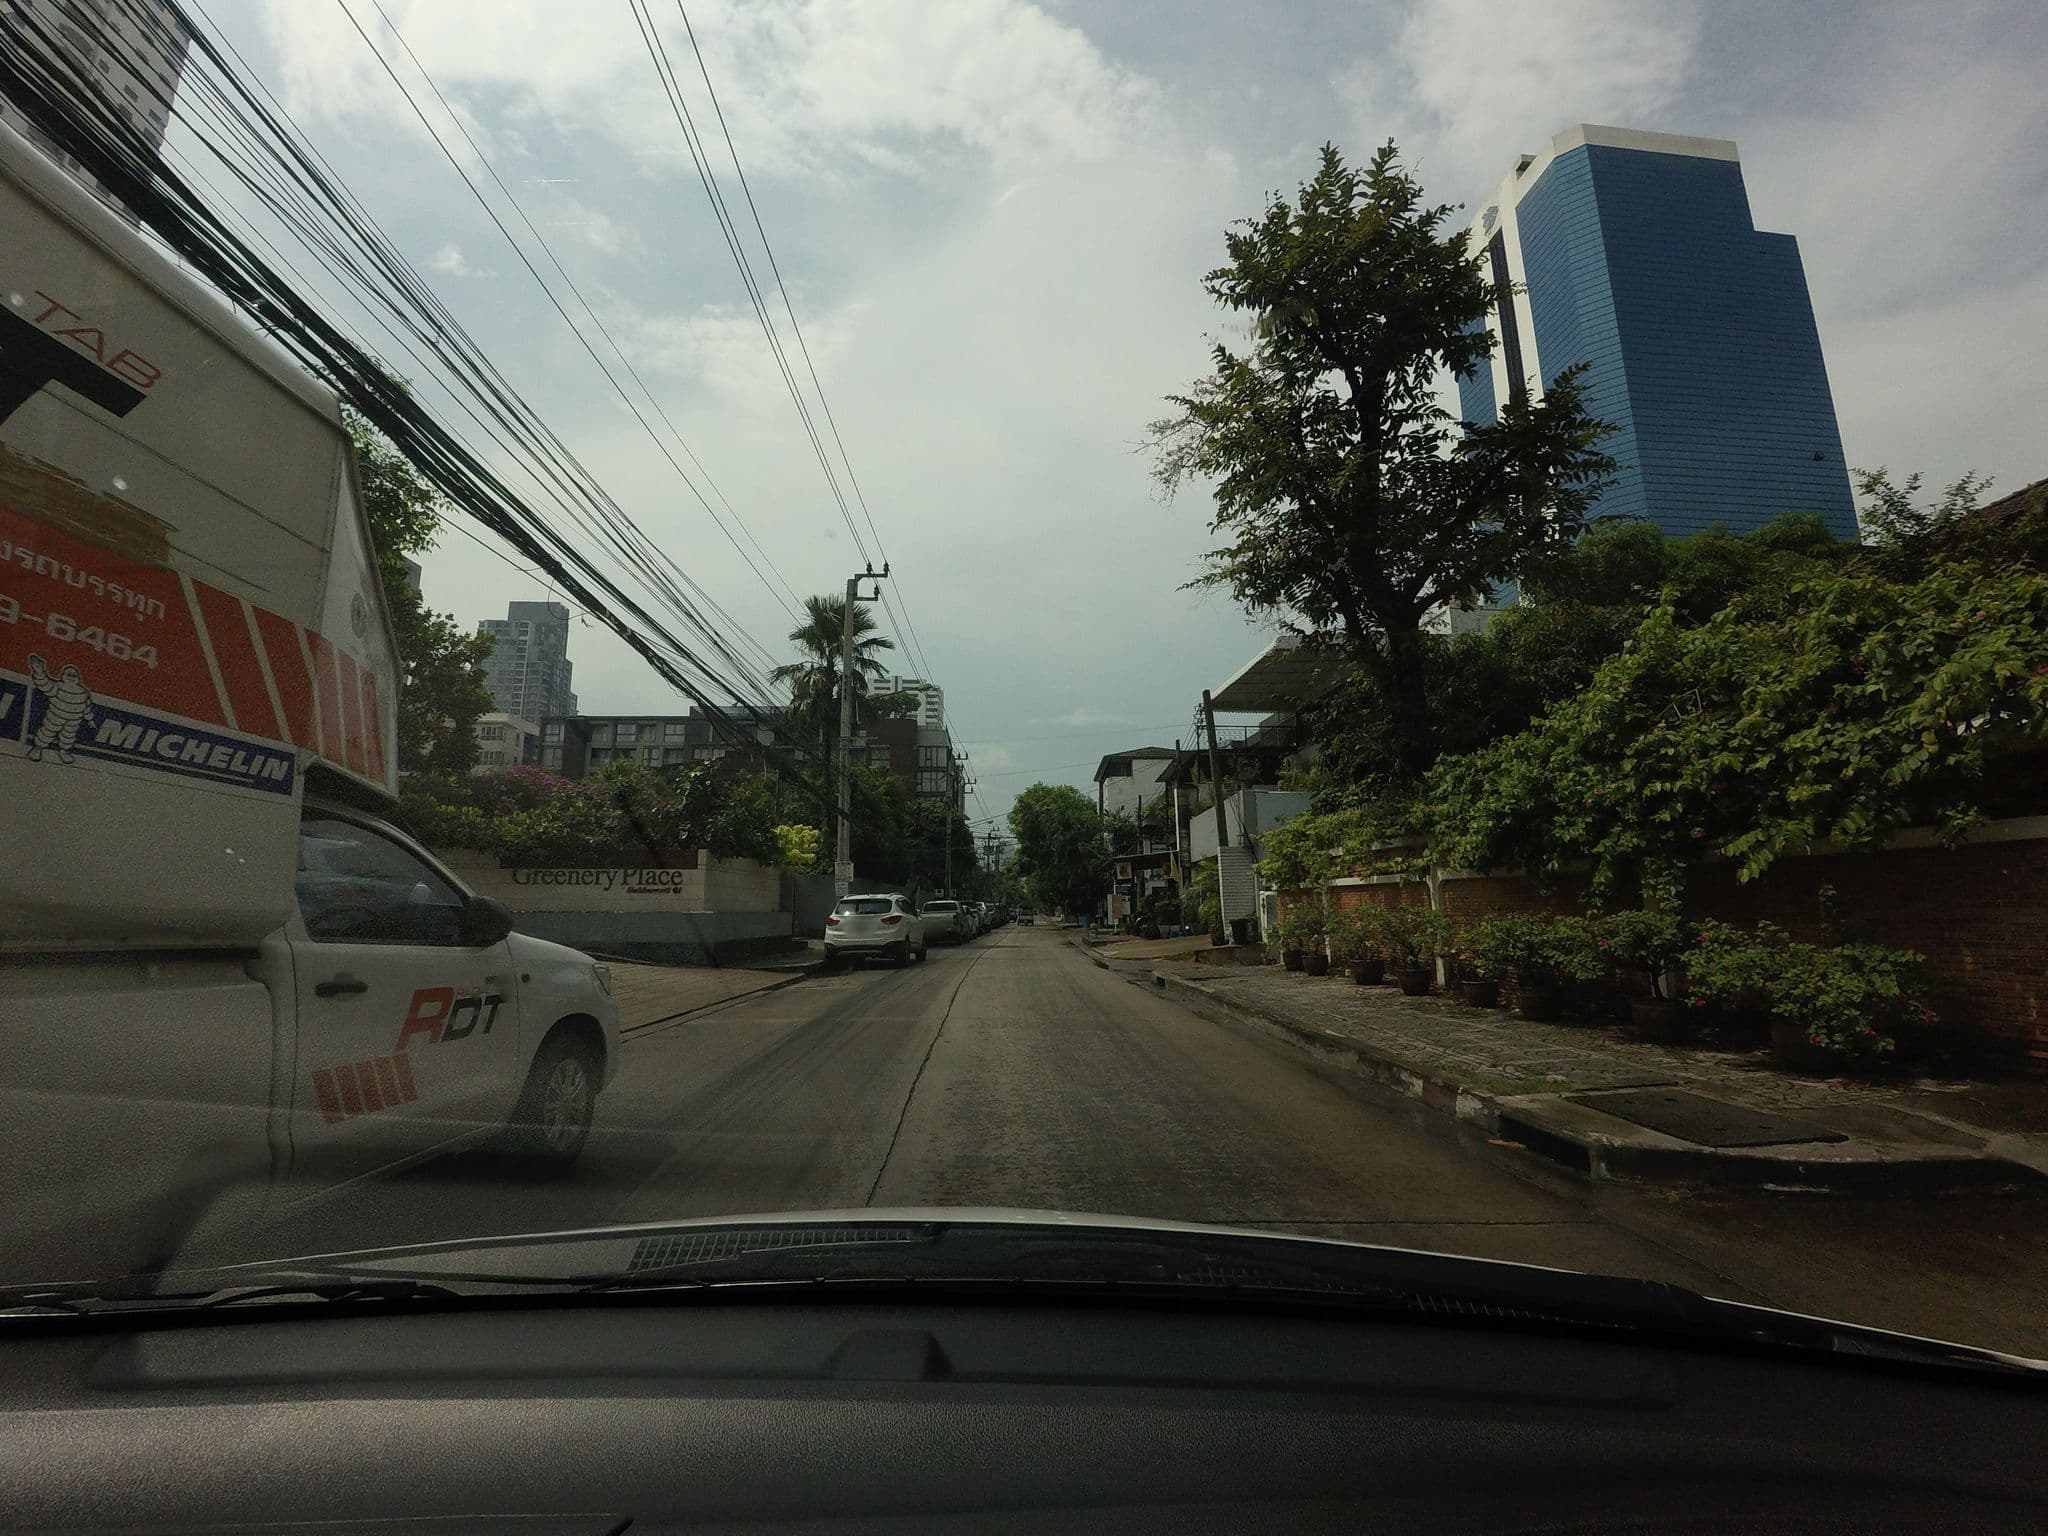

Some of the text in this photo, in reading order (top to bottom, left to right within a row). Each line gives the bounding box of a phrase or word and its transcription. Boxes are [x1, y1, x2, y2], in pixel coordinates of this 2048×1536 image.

[94, 718, 289, 781] MICHELIN
[511, 867, 618, 891] Greenery
[623, 867, 684, 886] Place
[396, 984, 507, 1051] RDT
